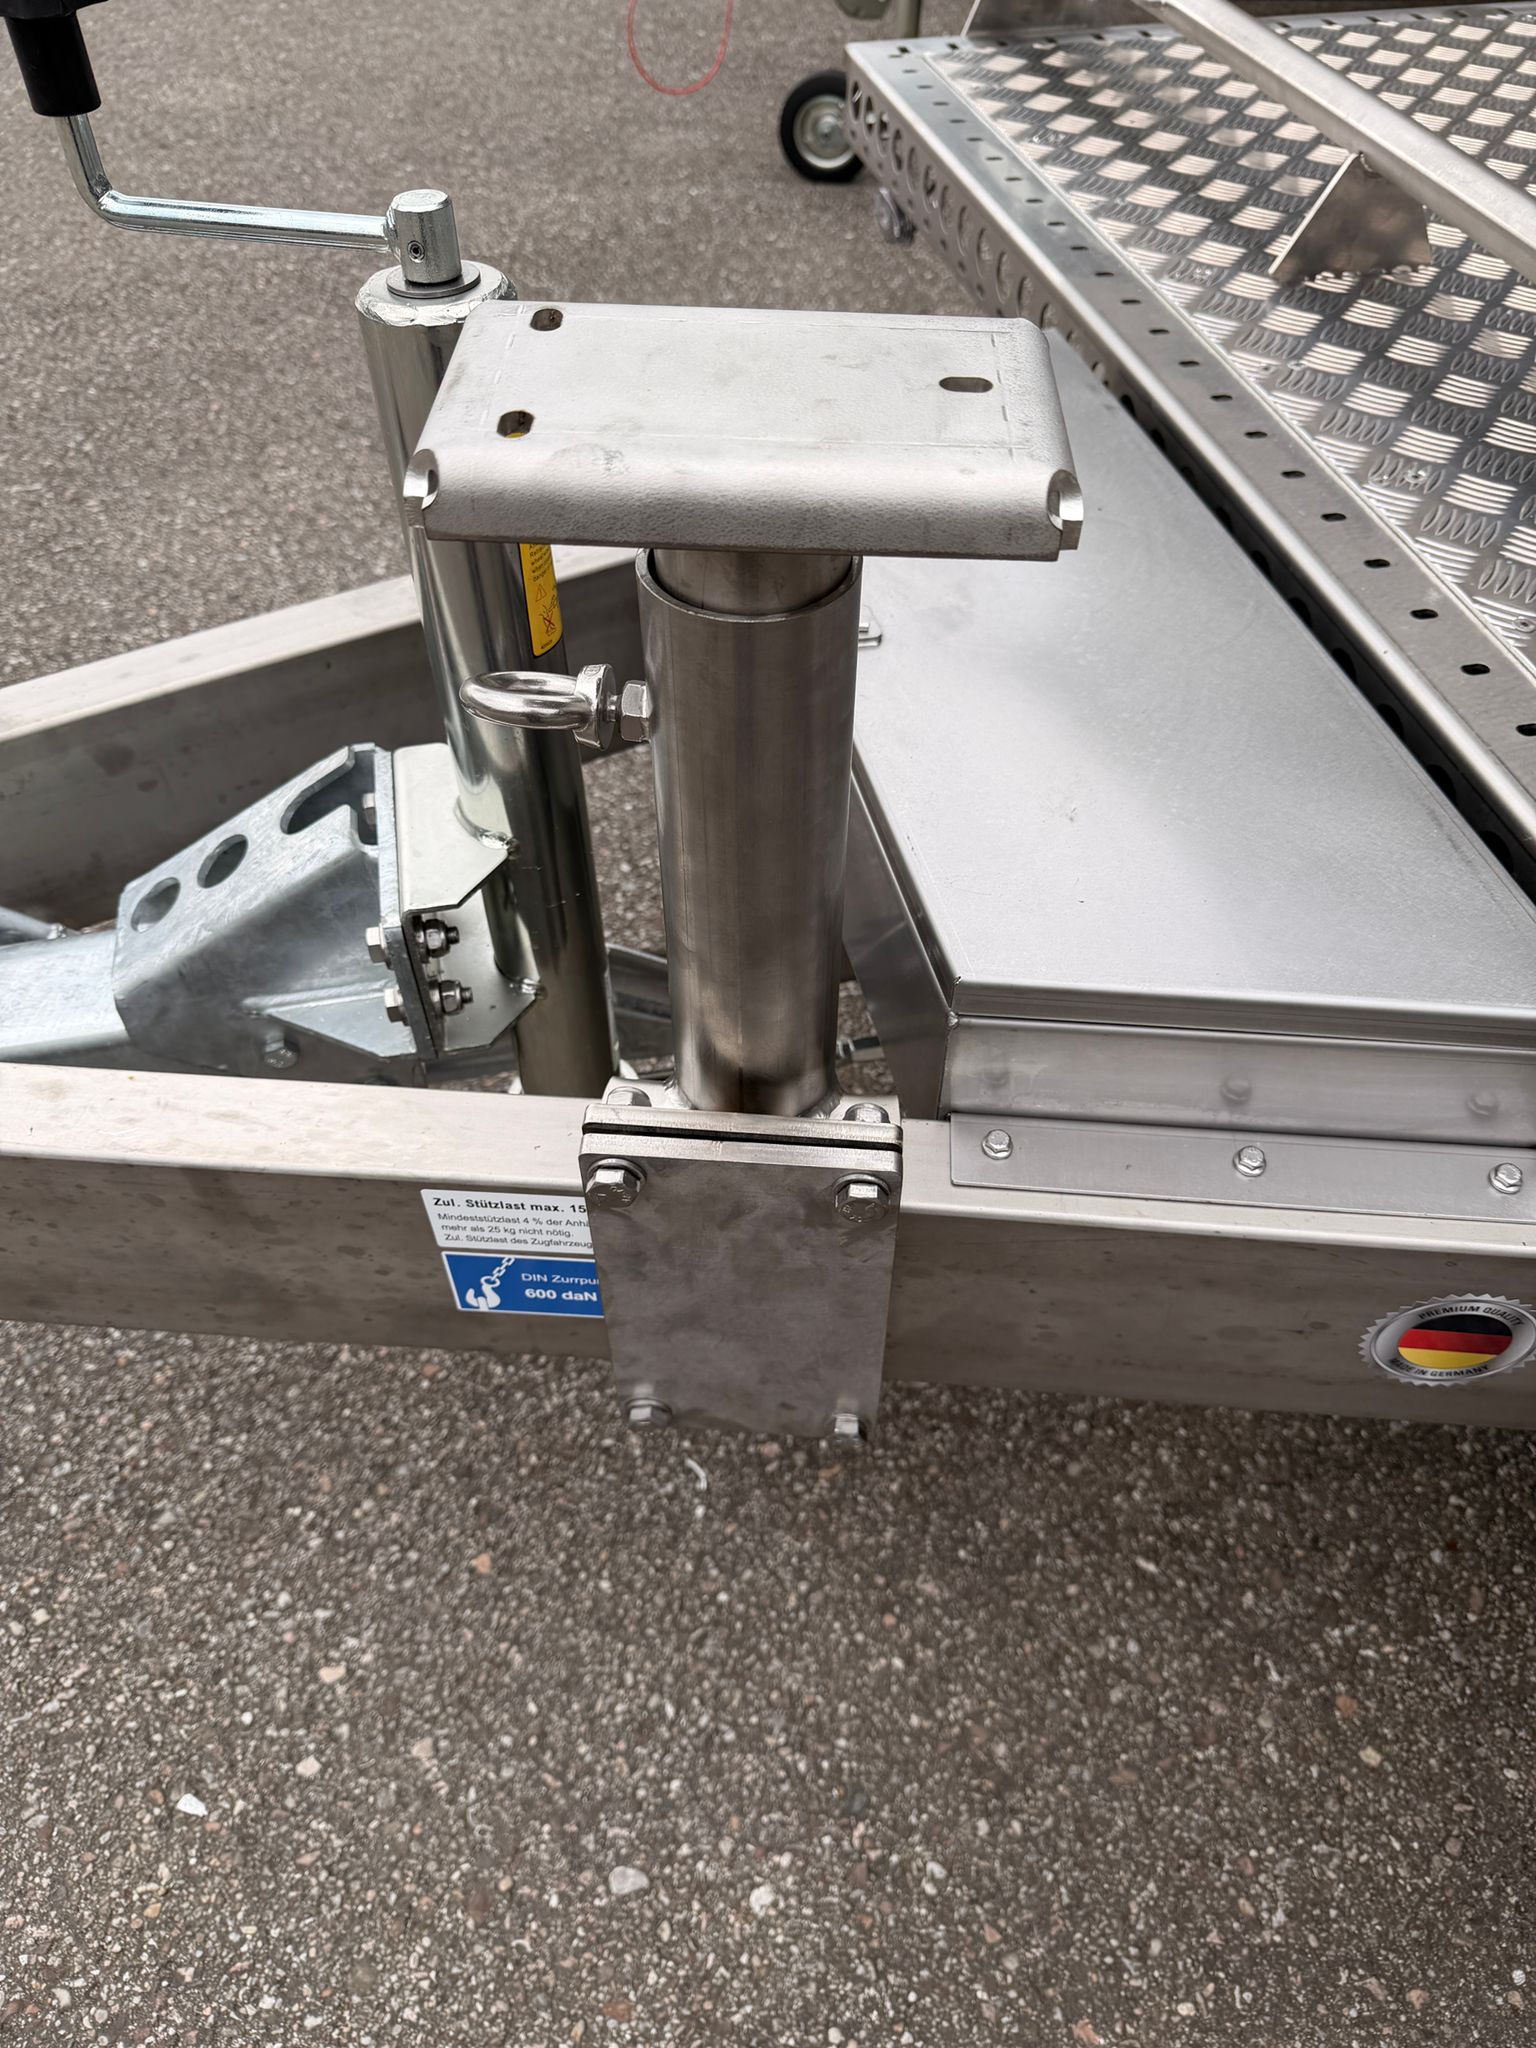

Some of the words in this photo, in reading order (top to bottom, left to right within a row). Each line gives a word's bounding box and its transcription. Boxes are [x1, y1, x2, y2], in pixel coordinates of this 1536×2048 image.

[433, 1197, 461, 1207] Zul.
[465, 1199, 526, 1210] Stützlast
[530, 1204, 565, 1212] max.
[437, 1213, 520, 1224] Mindeststützlast
[532, 1217, 543, 1225] %
[441, 1224, 467, 1232] mehr
[470, 1225, 485, 1233] als
[488, 1225, 501, 1233] 25
[503, 1227, 516, 1235] kg
[519, 1227, 543, 1236] nicht
[546, 1230, 574, 1238] nötig.
[465, 1234, 508, 1243] Stützlast
[521, 1273, 548, 1282] DIN
[524, 1288, 557, 1300] 600
[561, 1290, 598, 1302] daN
[1418, 1305, 1481, 1320] PREMIUM
[1482, 1306, 1525, 1327] QUALITY
[1430, 1364, 1489, 1377] GERMANY
